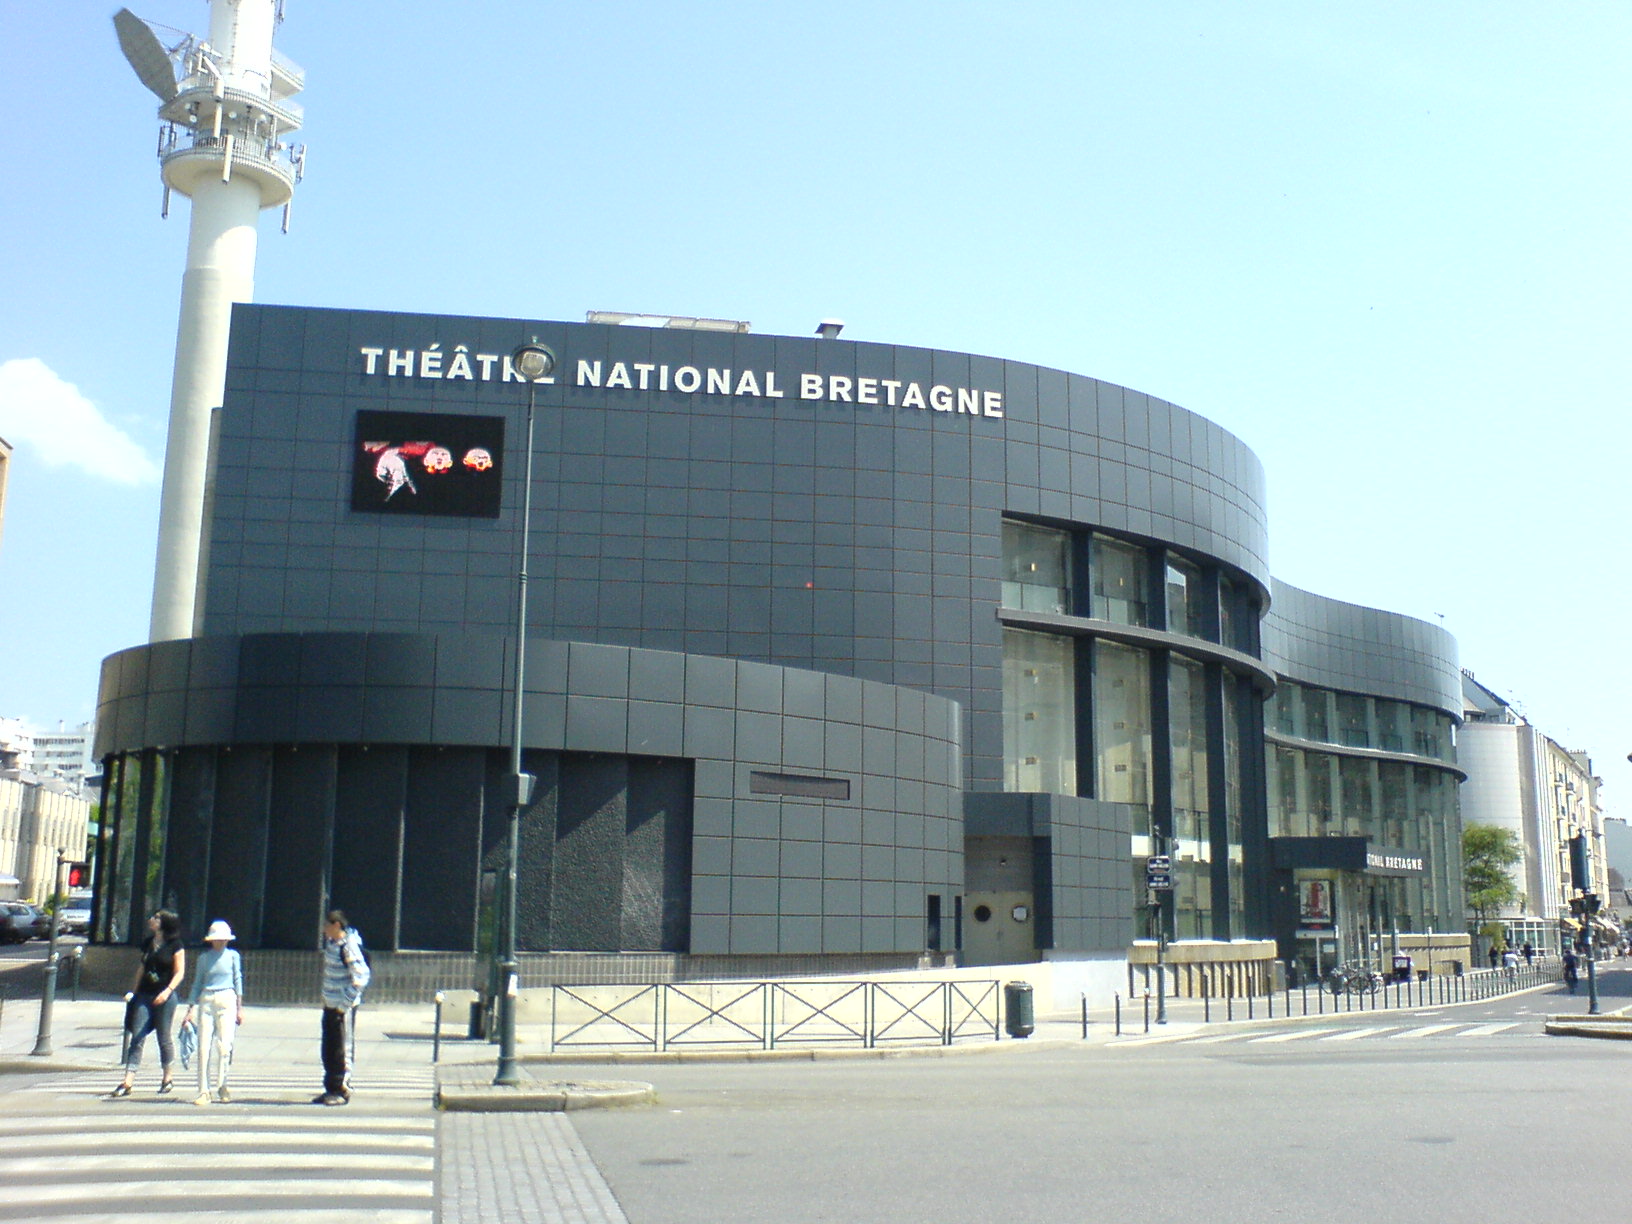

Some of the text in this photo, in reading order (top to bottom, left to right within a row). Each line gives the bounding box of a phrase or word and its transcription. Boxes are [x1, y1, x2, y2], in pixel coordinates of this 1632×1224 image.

[576, 360, 784, 399] NATIONAL
[800, 373, 1004, 418] BRETAGNE
[1385, 856, 1423, 871] BRETAGNE
